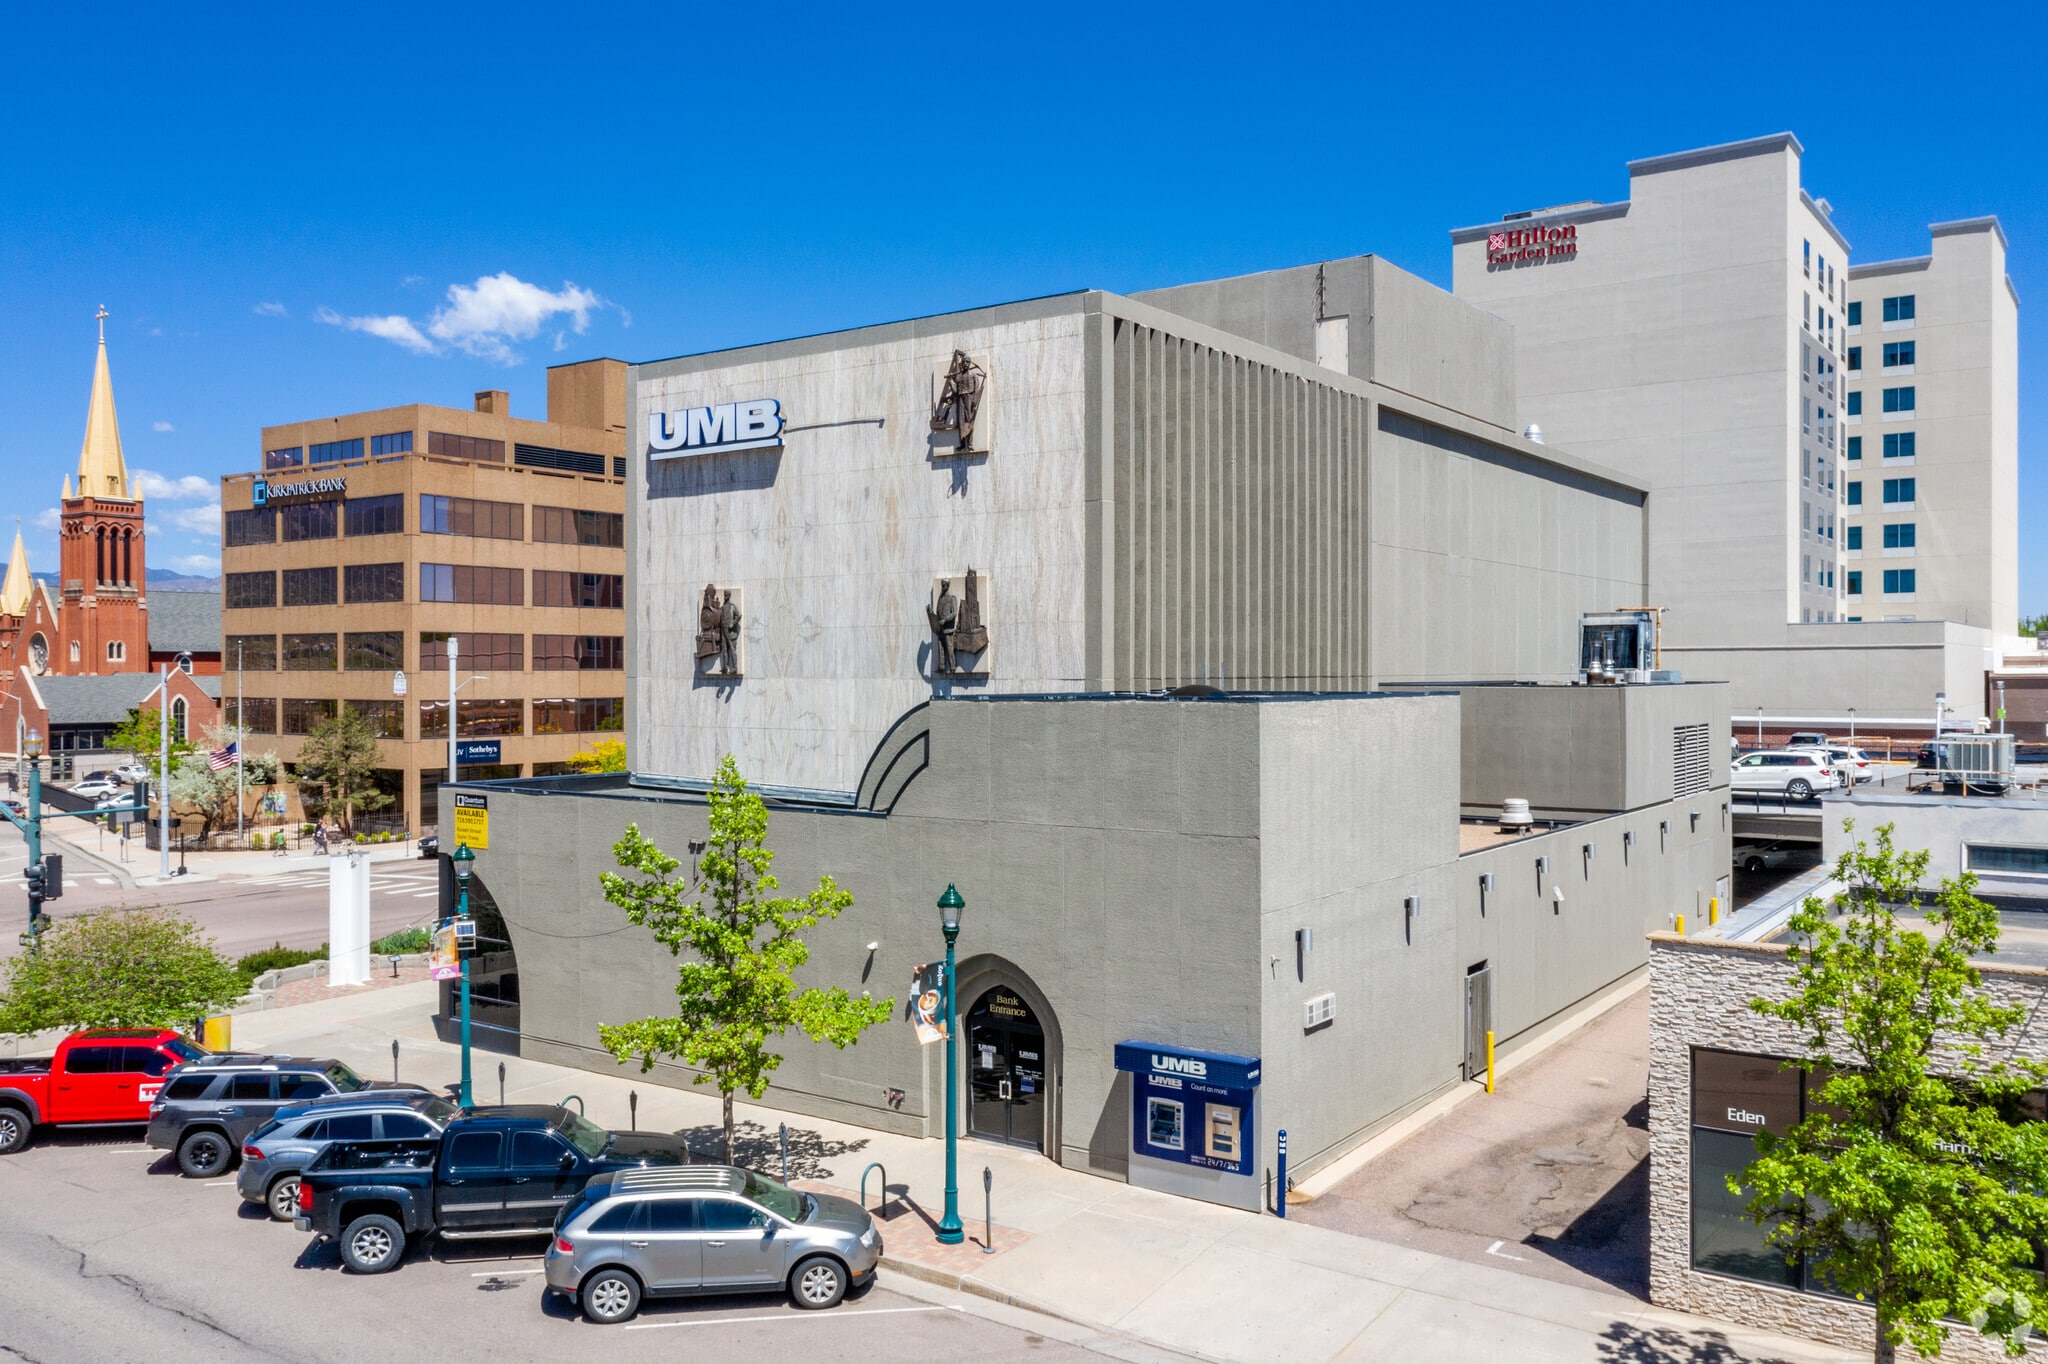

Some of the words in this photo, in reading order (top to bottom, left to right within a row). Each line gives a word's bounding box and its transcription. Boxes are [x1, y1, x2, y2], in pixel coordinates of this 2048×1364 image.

[1508, 225, 1576, 248] Hilton
[1489, 246, 1545, 264] Garden
[1549, 242, 1576, 256] Inn
[649, 398, 783, 452] UMB
[266, 480, 319, 498] KIRKPATRICK
[320, 477, 346, 492] BANK
[469, 744, 498, 754] Sotheby's
[457, 809, 485, 818] AVAILABLE
[997, 995, 1019, 1006] Bank
[989, 1004, 1026, 1017] Entrance
[1152, 1054, 1207, 1076] UMB
[1247, 1069, 1259, 1079] UMB
[1148, 1075, 1182, 1087] UMB
[1191, 1083, 1206, 1092] Count
[1728, 1107, 1765, 1125] Eden
[1207, 1158, 1240, 1171] 24/7/365
